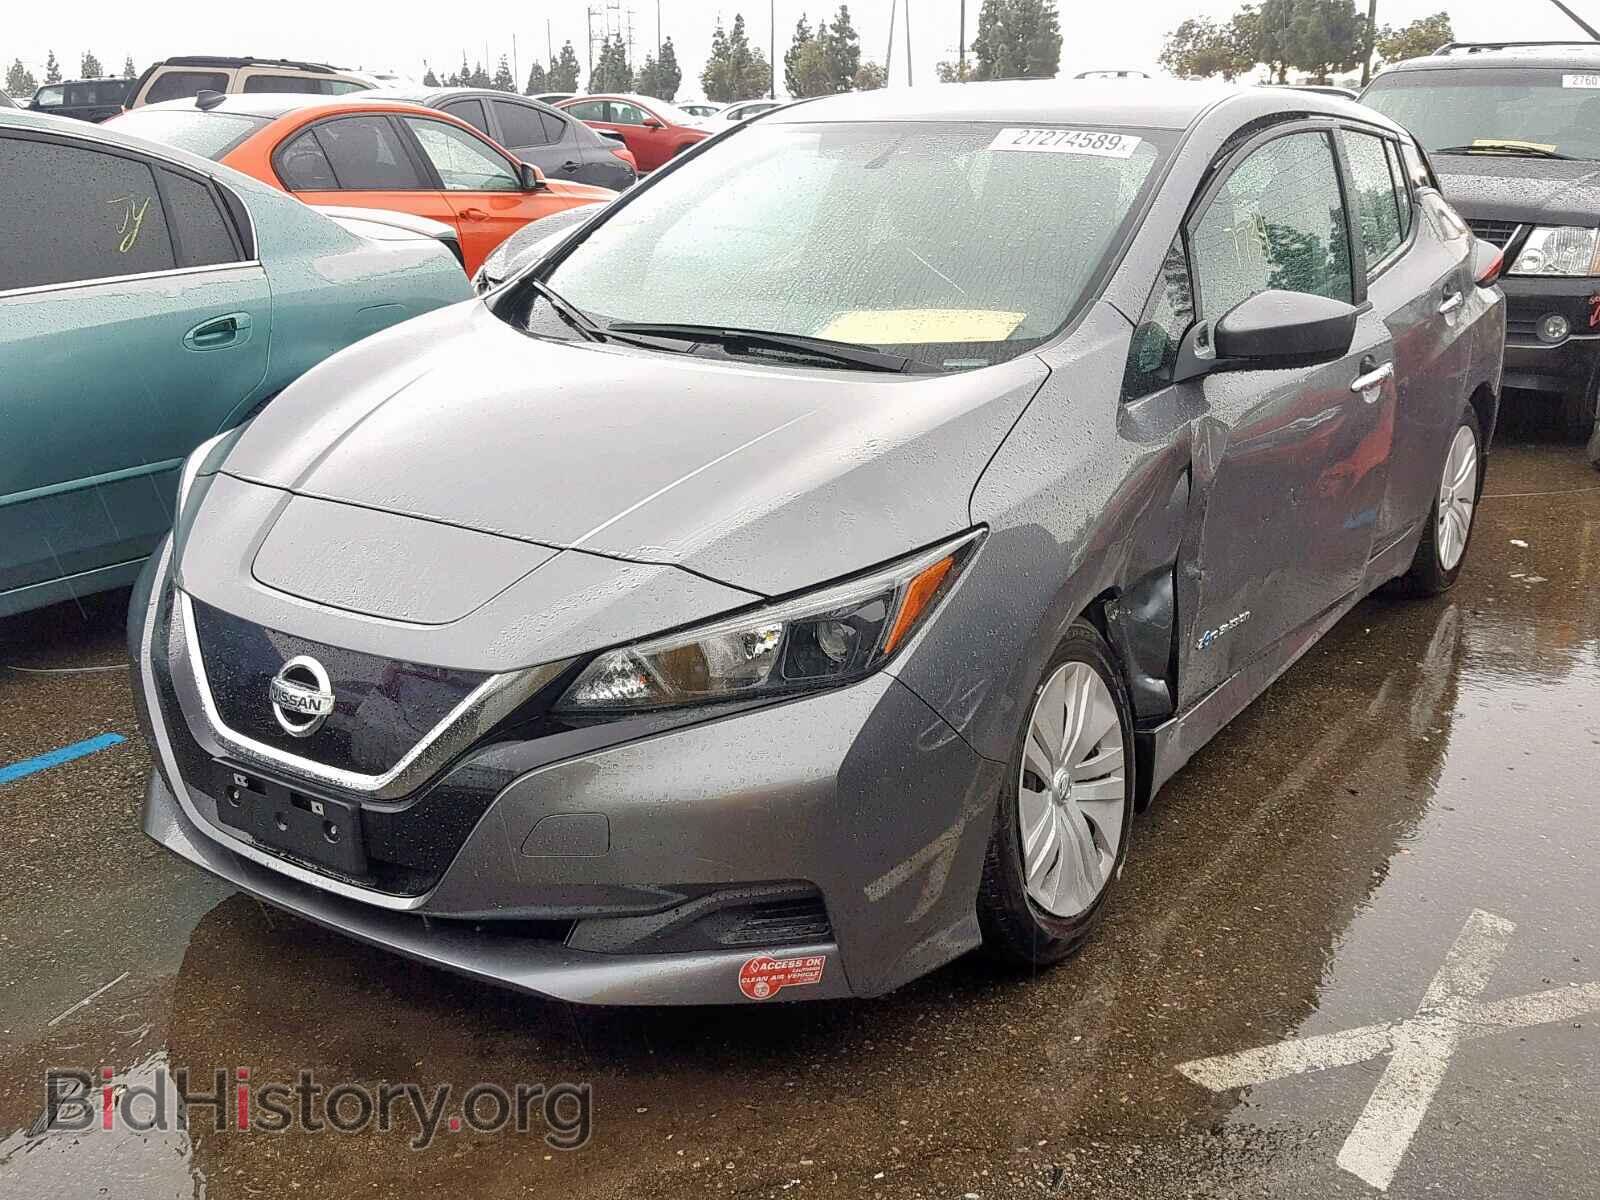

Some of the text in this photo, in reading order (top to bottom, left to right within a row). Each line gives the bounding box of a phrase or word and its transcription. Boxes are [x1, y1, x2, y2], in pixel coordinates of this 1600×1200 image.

[1011, 129, 1122, 151] 27274589
[272, 686, 322, 711] NISSAN
[760, 960, 803, 970] ACCESS
[806, 958, 822, 966] OK
[741, 976, 768, 984] CLEAN
[770, 973, 784, 981] AIR
[787, 971, 820, 980] VEHICLE
